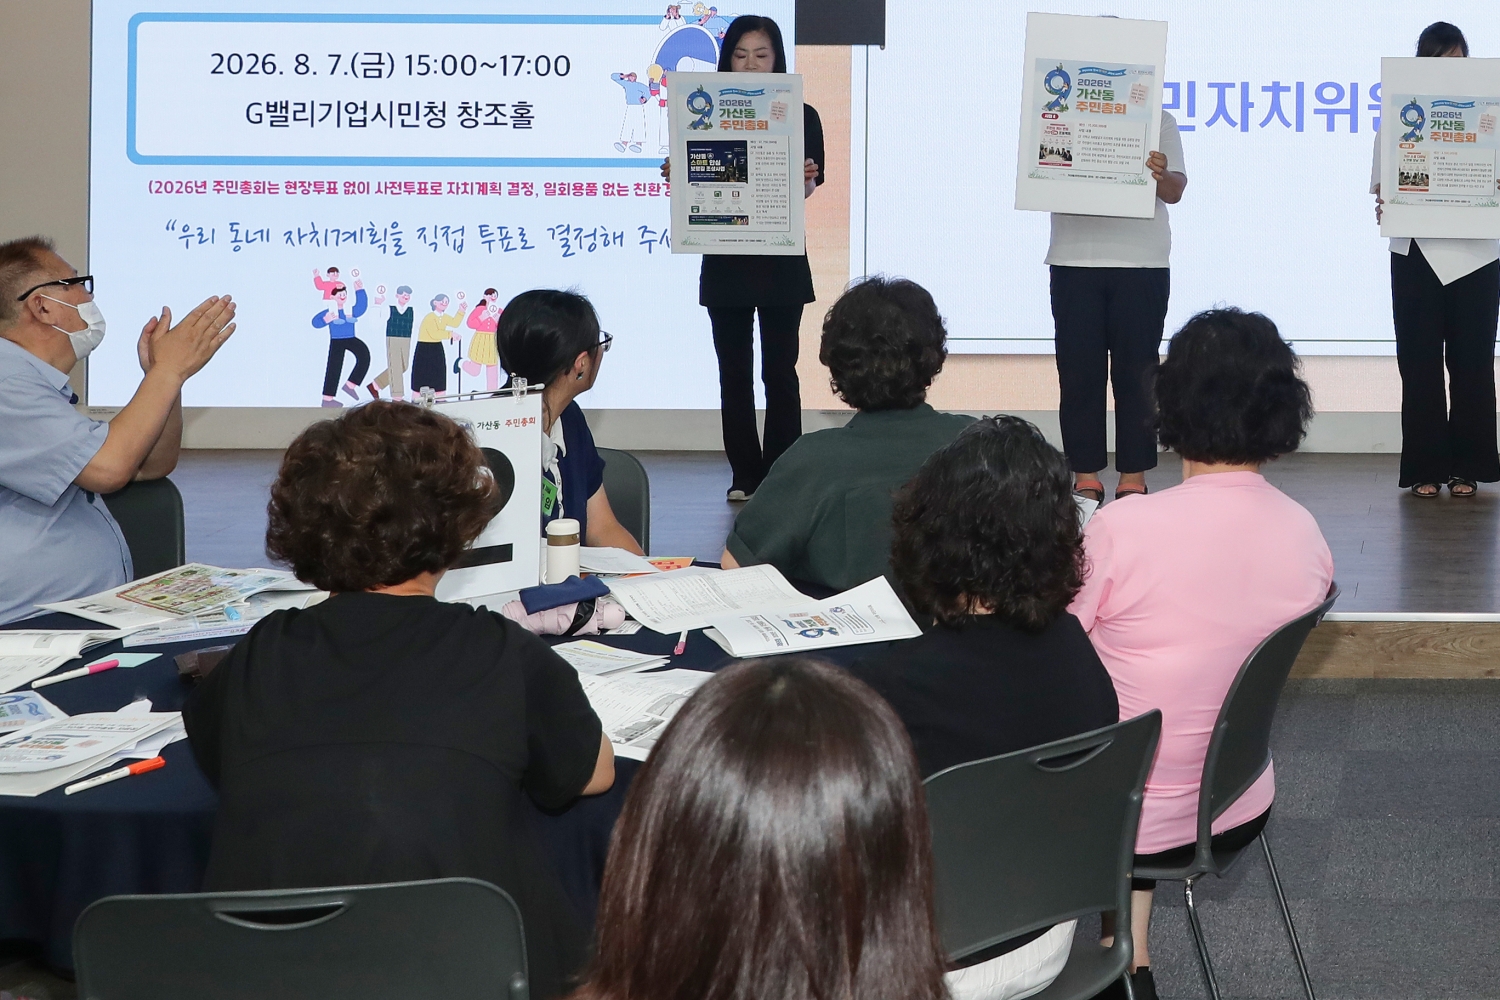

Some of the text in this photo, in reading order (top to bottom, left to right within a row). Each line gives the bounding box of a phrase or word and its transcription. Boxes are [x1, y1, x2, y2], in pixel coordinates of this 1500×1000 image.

[210, 53, 284, 76] 2026.
[294, 53, 317, 76] 8.
[404, 53, 571, 77] 15:00~17:00
[1076, 88, 1115, 101] 가산동
[246, 100, 536, 129] G밸리기업시민청 창조홀
[719, 108, 756, 119] 가산동
[719, 119, 769, 131] 주민총회
[1430, 120, 1466, 131] 가산동
[1430, 131, 1477, 143] 주민총회
[148, 180, 629, 198] (2026년 주민총회는 현장투표 없이 사전투표로 자치계획 결정, 일회용품 없는
[229, 221, 624, 258] 동네 자치계획을 직접 투표로 결정해
